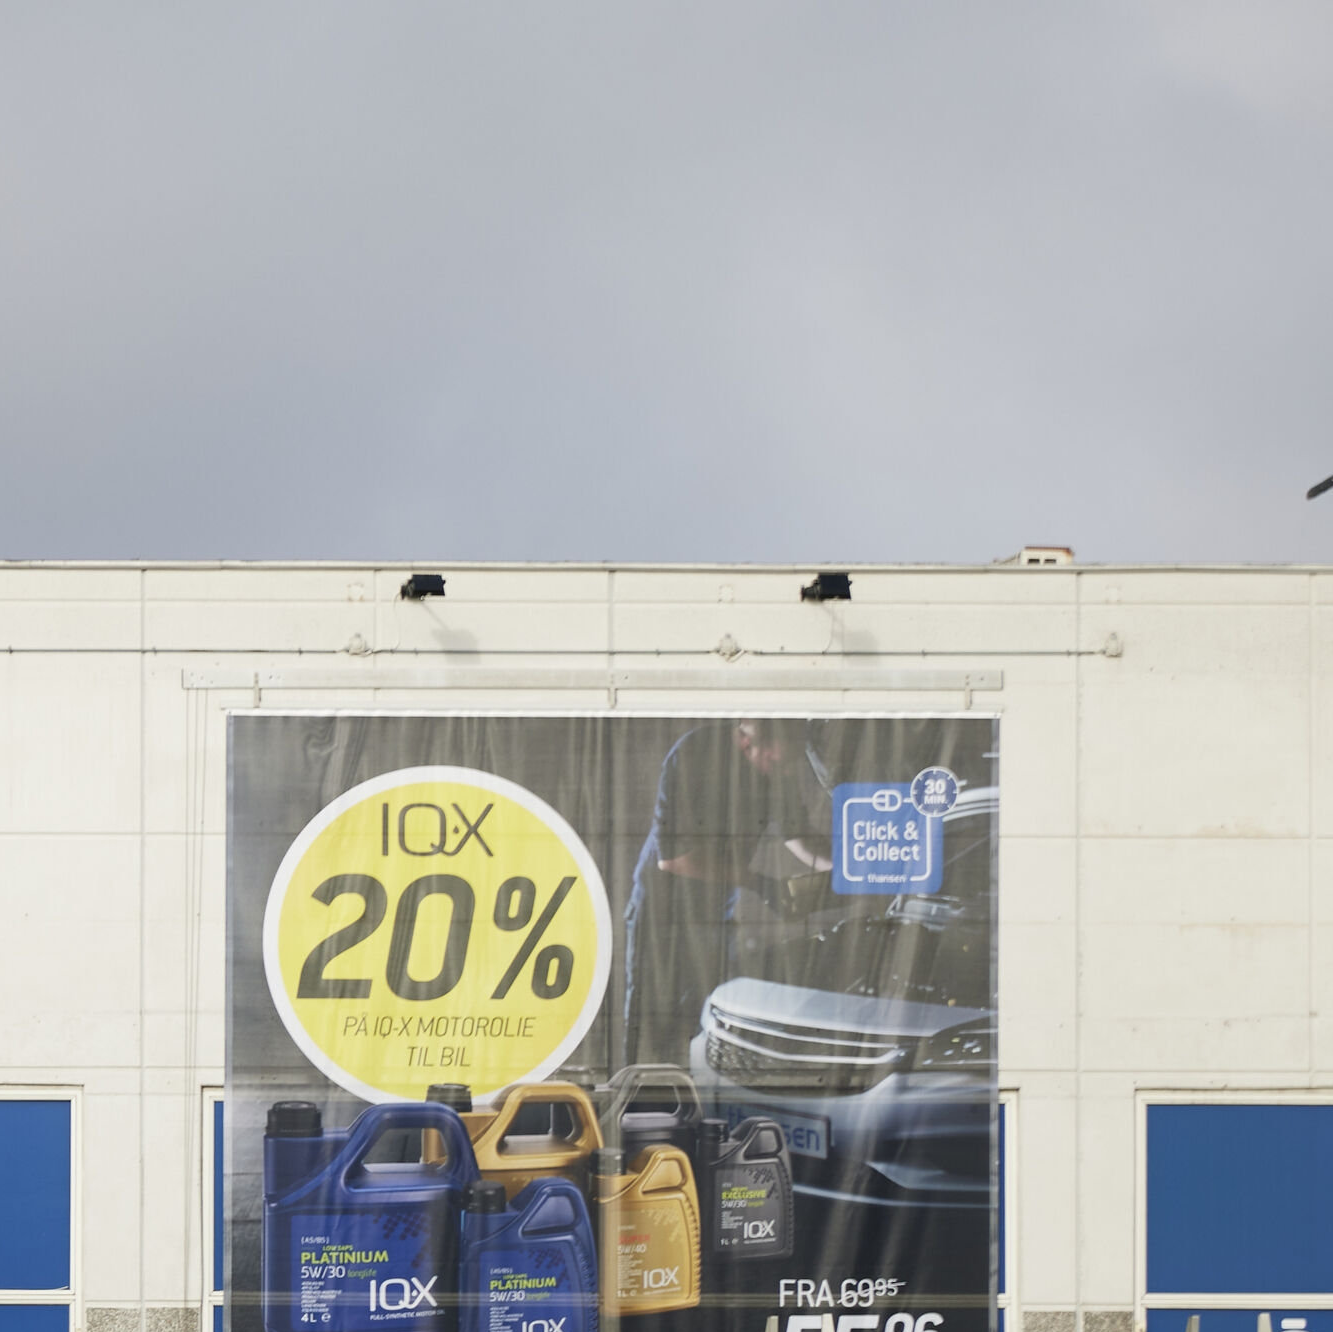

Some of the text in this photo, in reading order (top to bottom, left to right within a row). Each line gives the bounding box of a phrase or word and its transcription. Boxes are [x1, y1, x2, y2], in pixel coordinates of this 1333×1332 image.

[924, 779, 946, 794] 30
[382, 803, 494, 857] IQX
[853, 821, 919, 841] Click &
[853, 842, 921, 861] Collect
[867, 874, 907, 884] thansen
[296, 874, 577, 1001] 20%
[343, 1013, 536, 1038] PÅ IQ-X MOTOROLIE
[407, 1046, 471, 1067] TIL BIL
[744, 1219, 775, 1239] IQX
[301, 1250, 389, 1264] PLATINIUM
[301, 1266, 346, 1279] 5W/30
[643, 1266, 679, 1289] IQX
[370, 1275, 438, 1312] IQX
[490, 1277, 557, 1290] PLATINIUM
[779, 1279, 834, 1308] FRA
[489, 1290, 525, 1302] 5W/30
